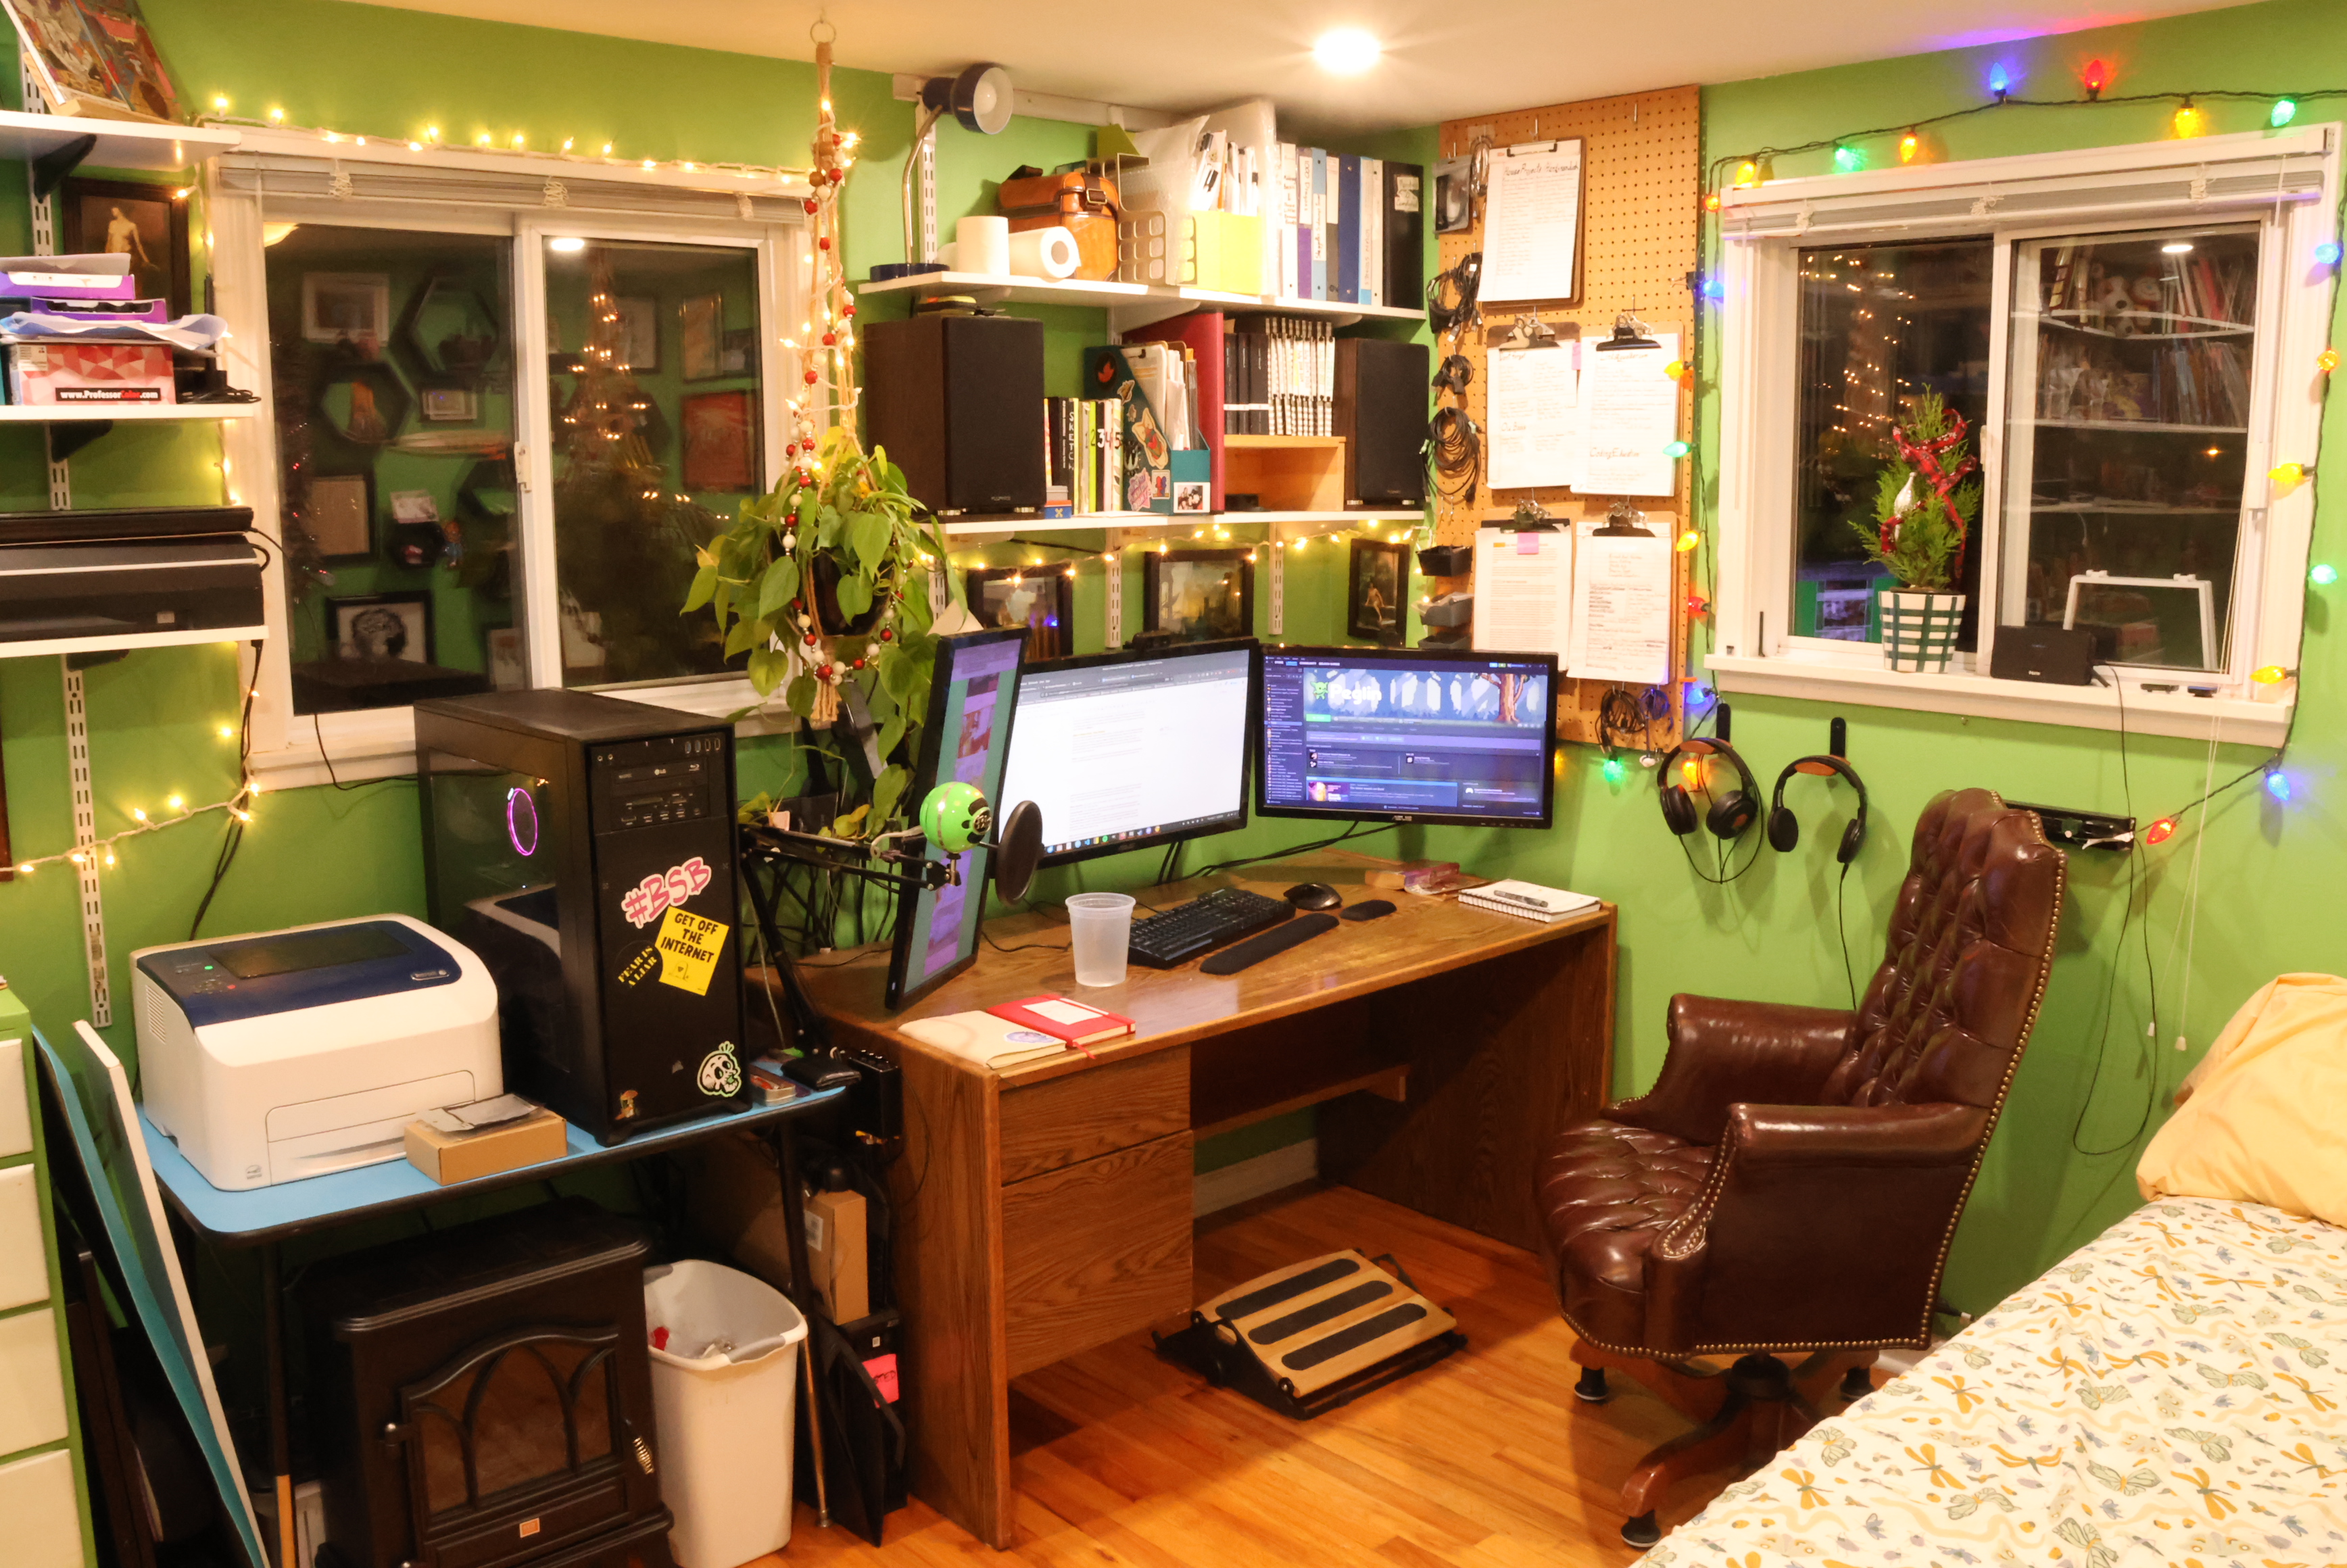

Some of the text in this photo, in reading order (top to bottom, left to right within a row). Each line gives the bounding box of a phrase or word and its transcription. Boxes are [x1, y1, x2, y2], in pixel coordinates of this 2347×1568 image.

[60, 389, 159, 401] www.ProfessorColor.com
[1090, 428, 1096, 446] 2
[1096, 428, 1105, 448] 3
[1114, 431, 1123, 449] 5
[1330, 683, 1382, 705] Peglin
[623, 858, 710, 927] #BSB
[675, 912, 719, 935] GET OFF
[682, 928, 704, 945] THE
[660, 937, 715, 963] INTERNET
[618, 945, 654, 983] FEAR IS
[634, 956, 658, 981] LIAR
